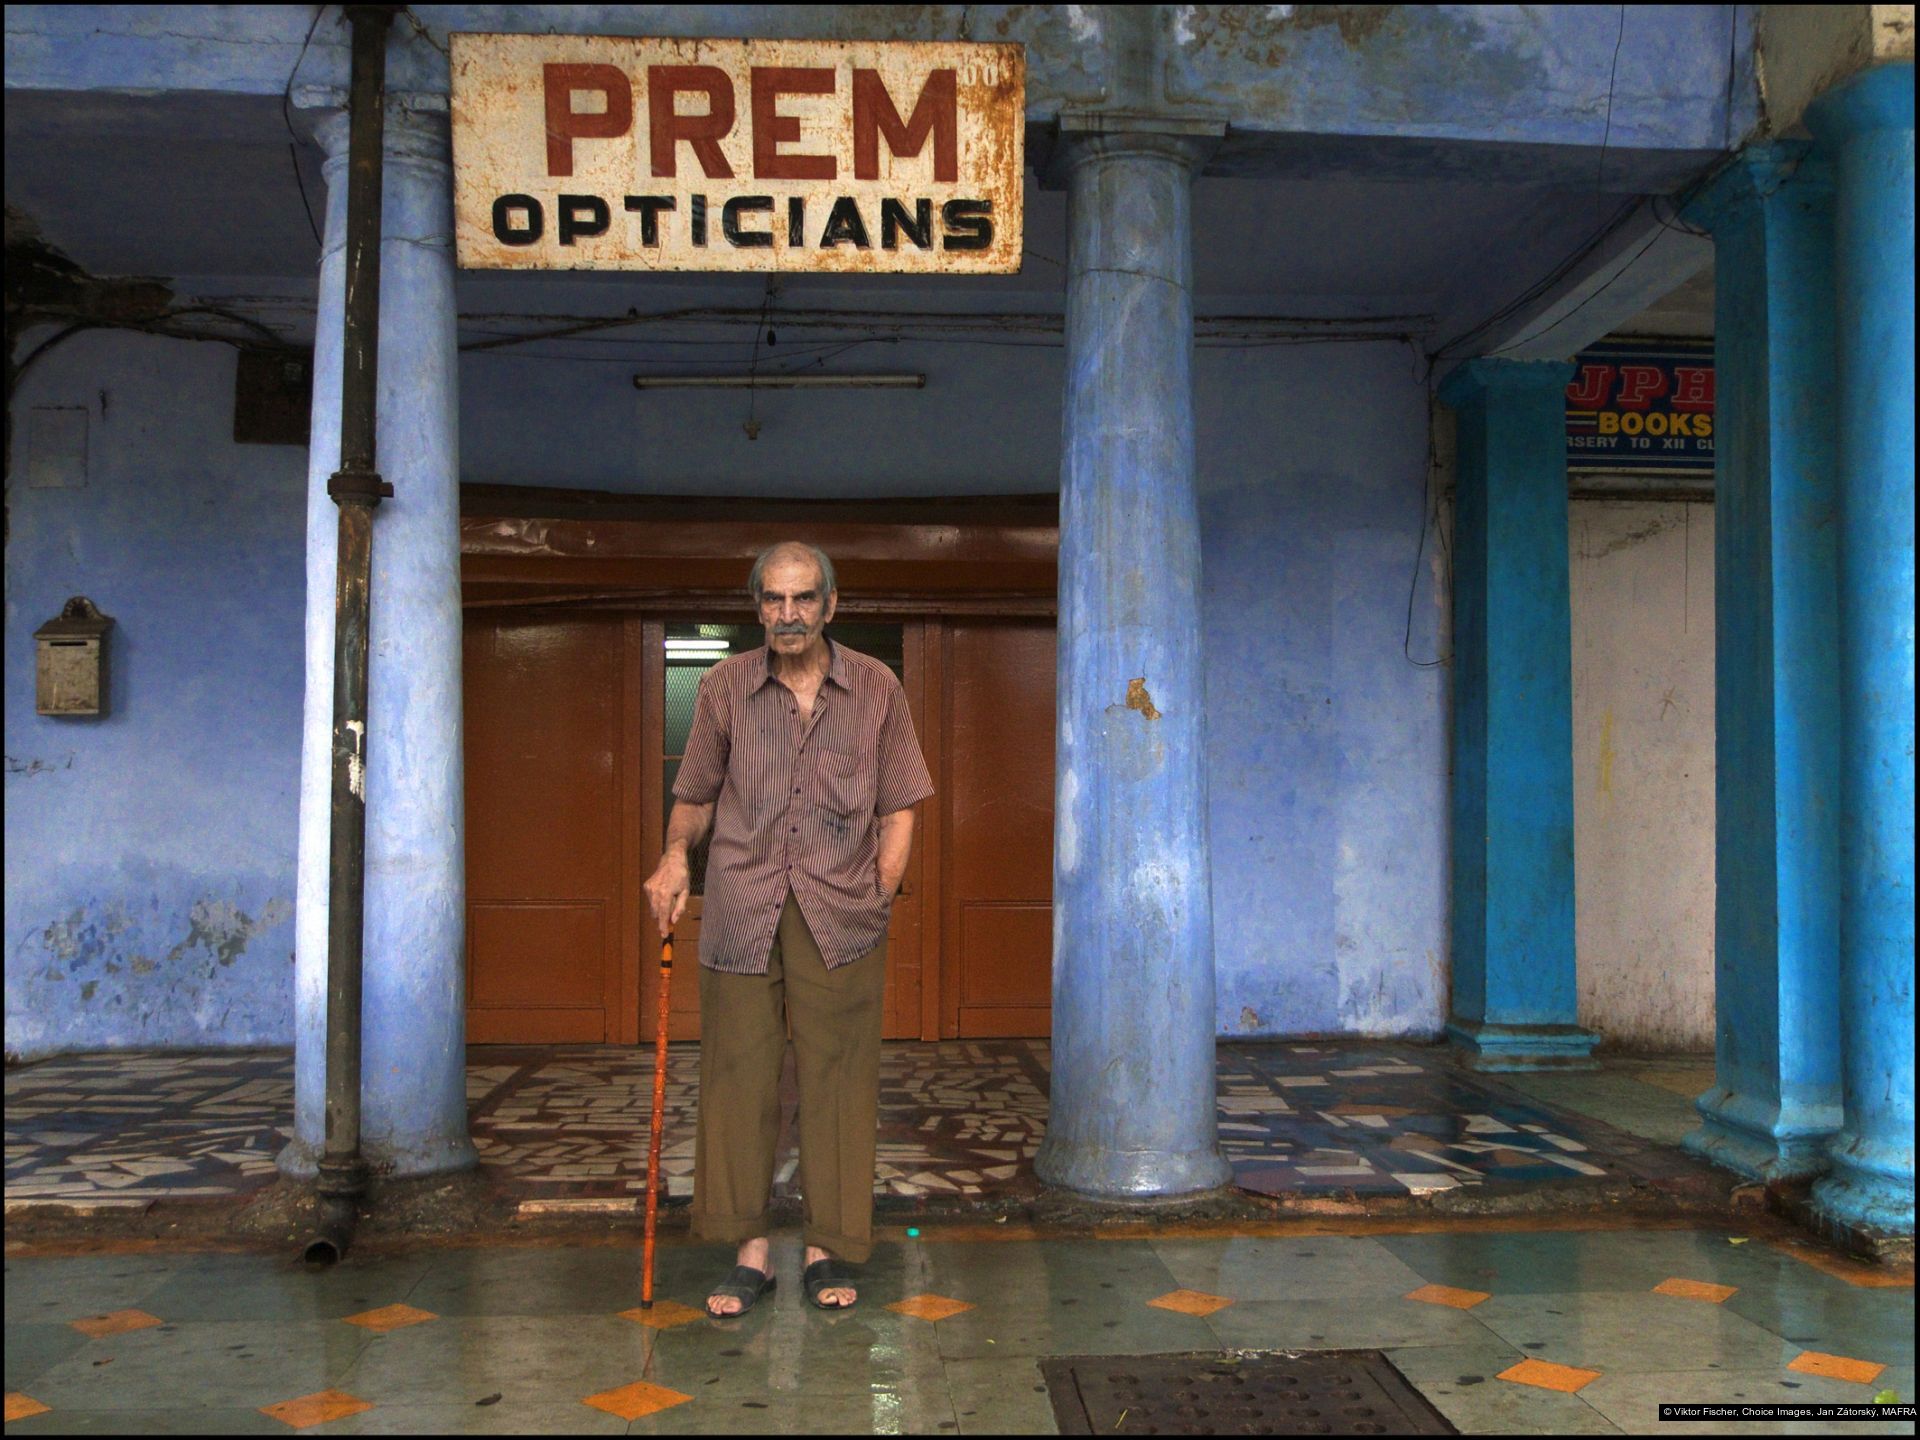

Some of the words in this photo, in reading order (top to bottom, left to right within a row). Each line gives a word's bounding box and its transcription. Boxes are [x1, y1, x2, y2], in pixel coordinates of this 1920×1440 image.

[543, 62, 959, 182] PREM
[491, 192, 995, 252] OPTICIANS
[1598, 411, 1713, 437] BOOKS
[1631, 437, 1650, 449] TO
[1663, 438, 1685, 449] XII
